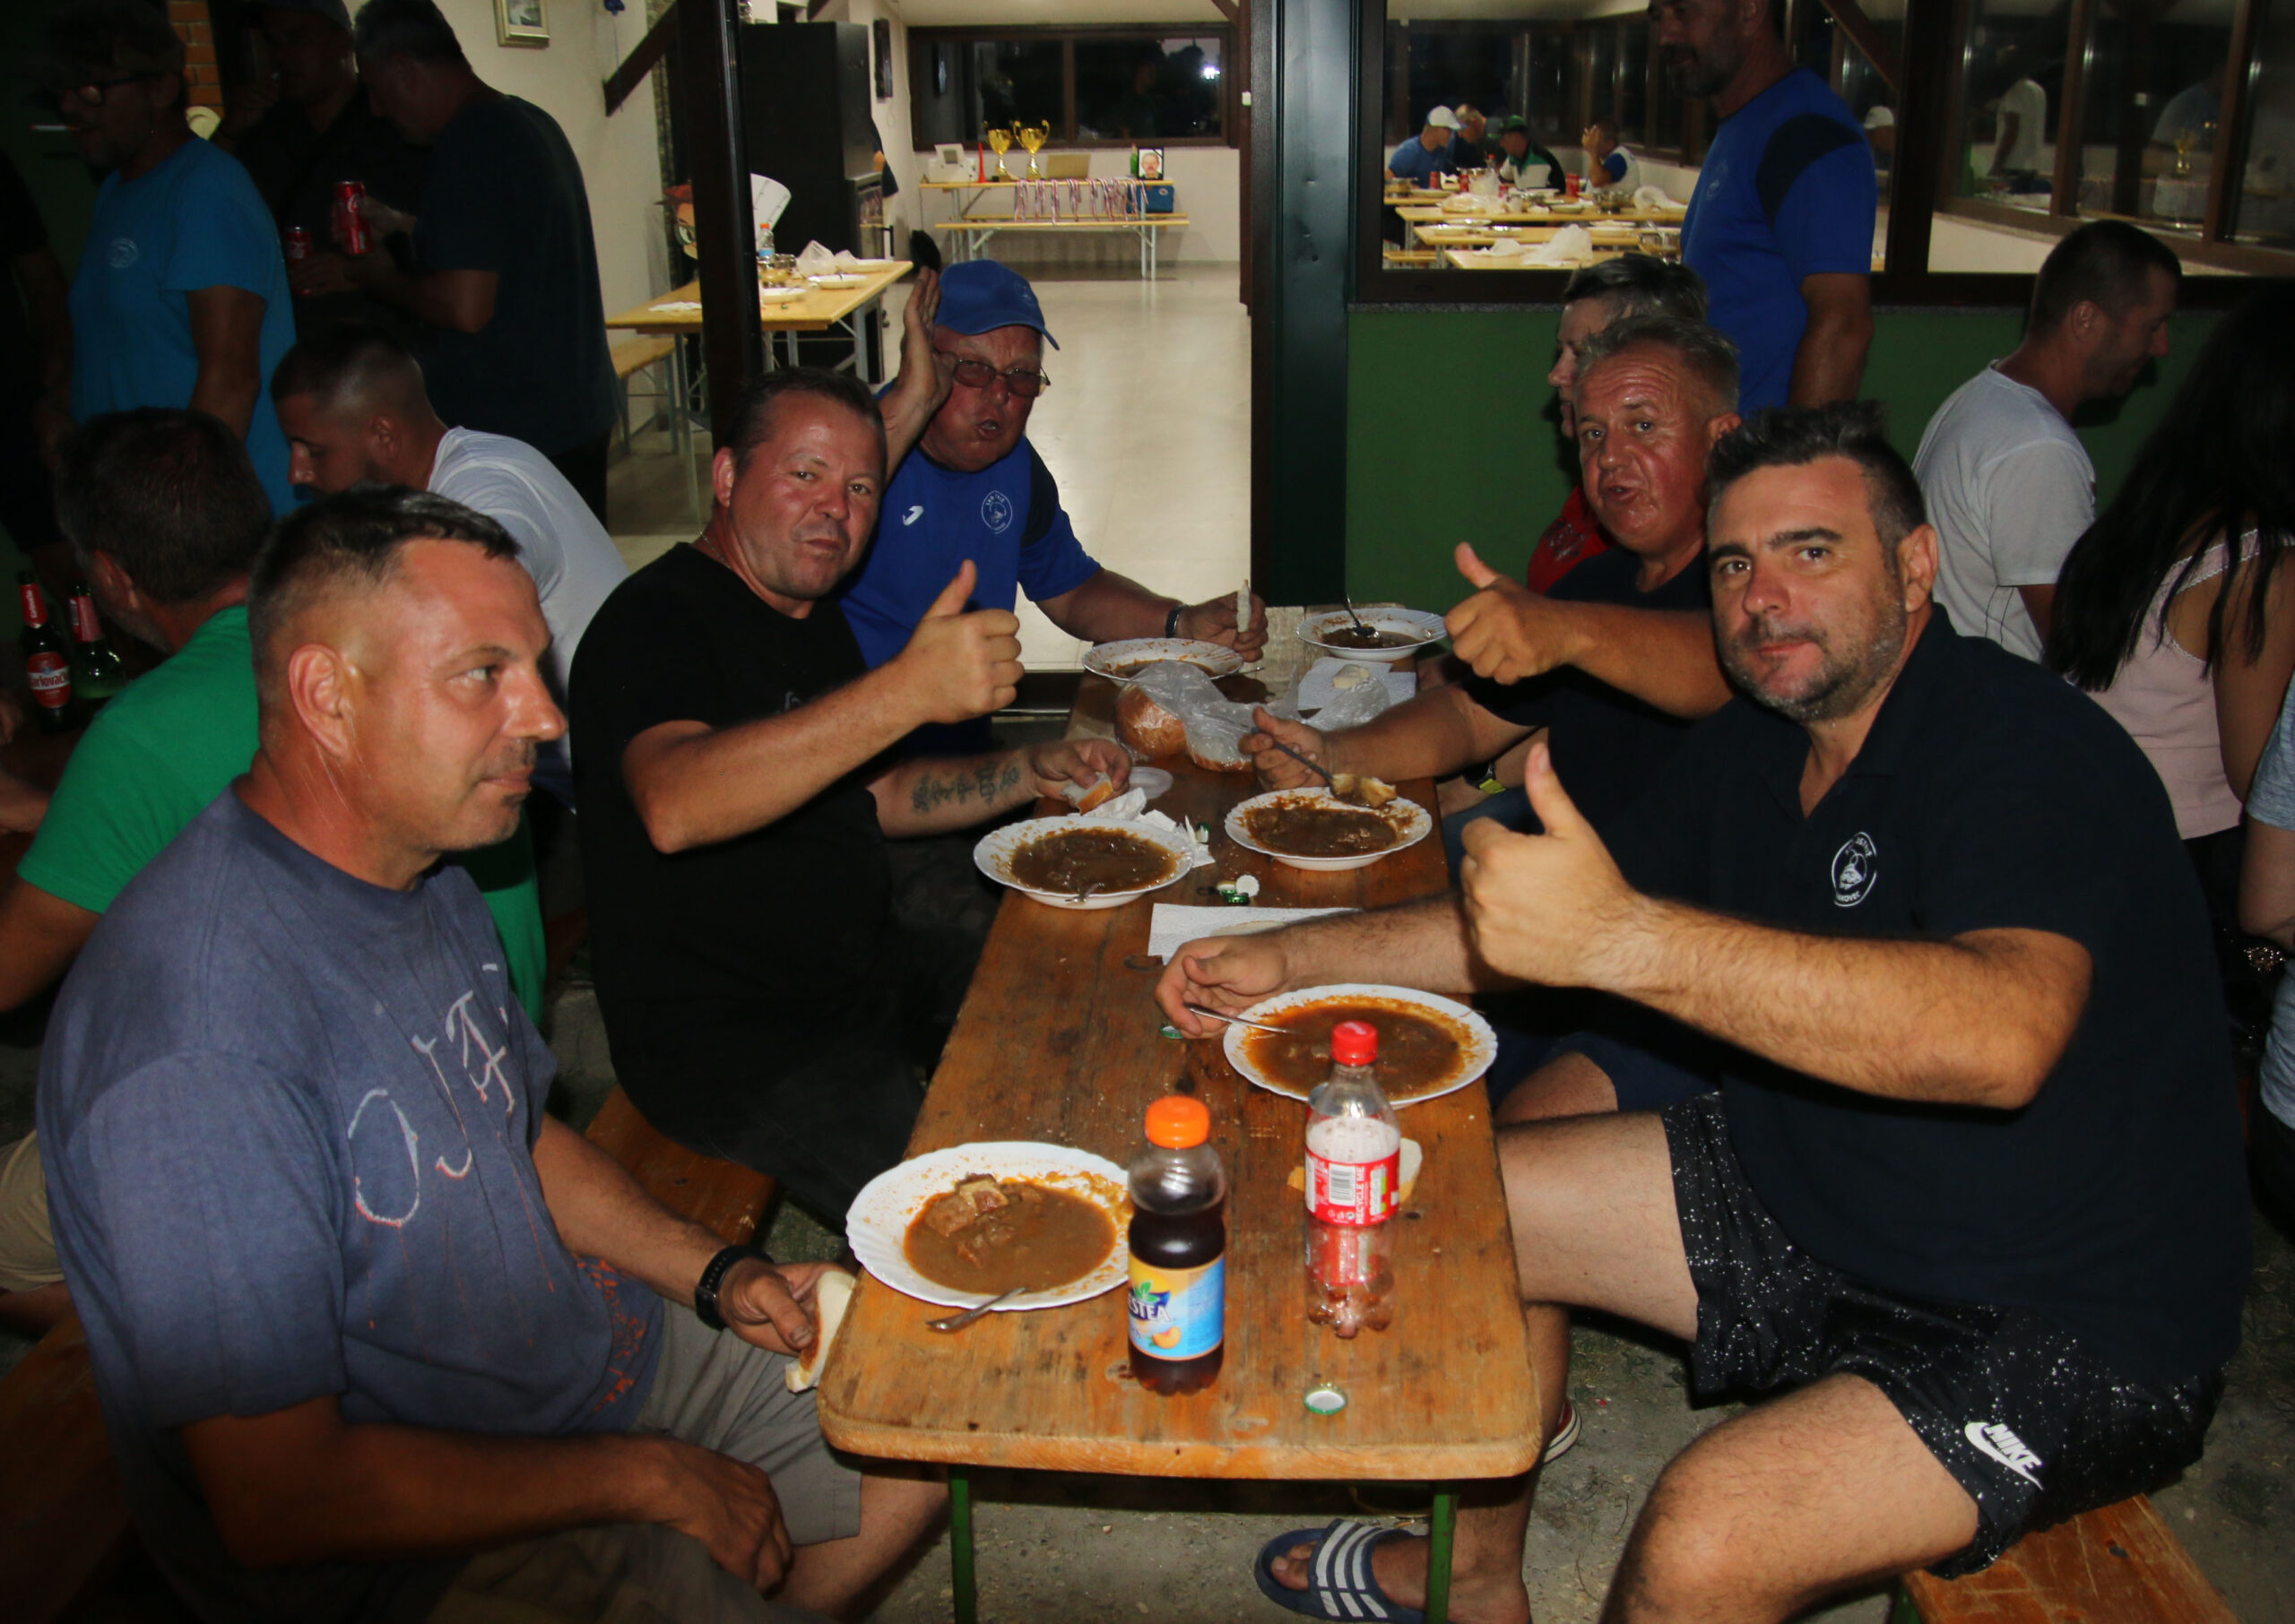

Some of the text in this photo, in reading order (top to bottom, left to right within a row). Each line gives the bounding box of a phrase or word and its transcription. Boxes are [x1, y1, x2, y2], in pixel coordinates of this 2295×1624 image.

[1355, 1166, 1365, 1224] RECYCLE ME
[1984, 1423, 2043, 1470] NIKE
